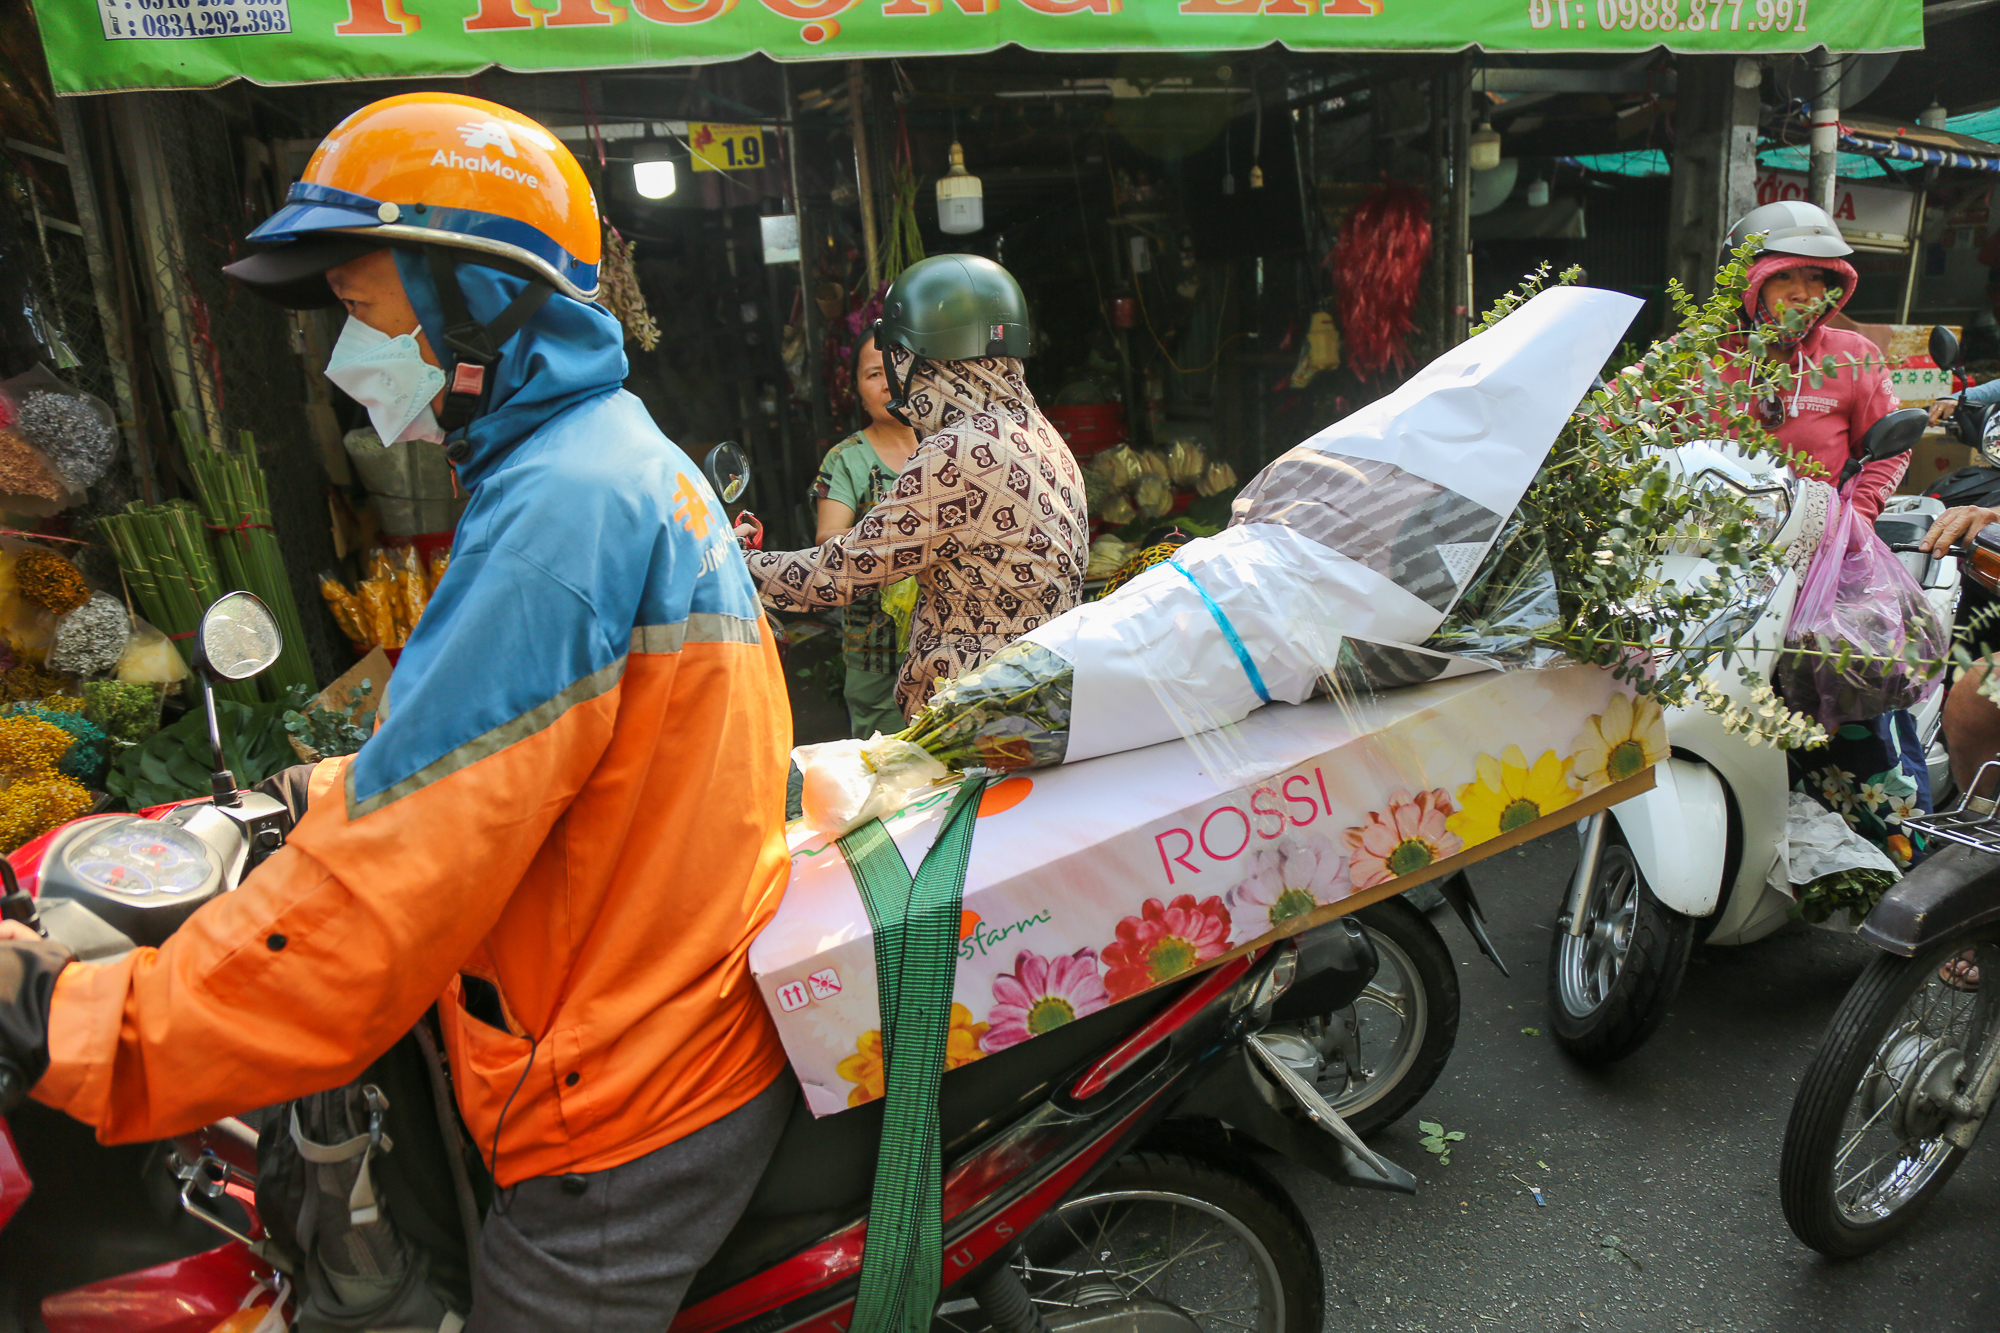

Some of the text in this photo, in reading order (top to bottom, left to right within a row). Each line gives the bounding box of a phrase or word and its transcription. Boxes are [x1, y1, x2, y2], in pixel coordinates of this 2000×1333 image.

[142, 9, 286, 37] 0834.292.393
[1599, 0, 1807, 32] 0988.877.991
[430, 149, 538, 189] AhaMove
[722, 136, 760, 166] 1.9
[1155, 767, 1333, 885] ROSSI
[958, 914, 1052, 961] sfarm
